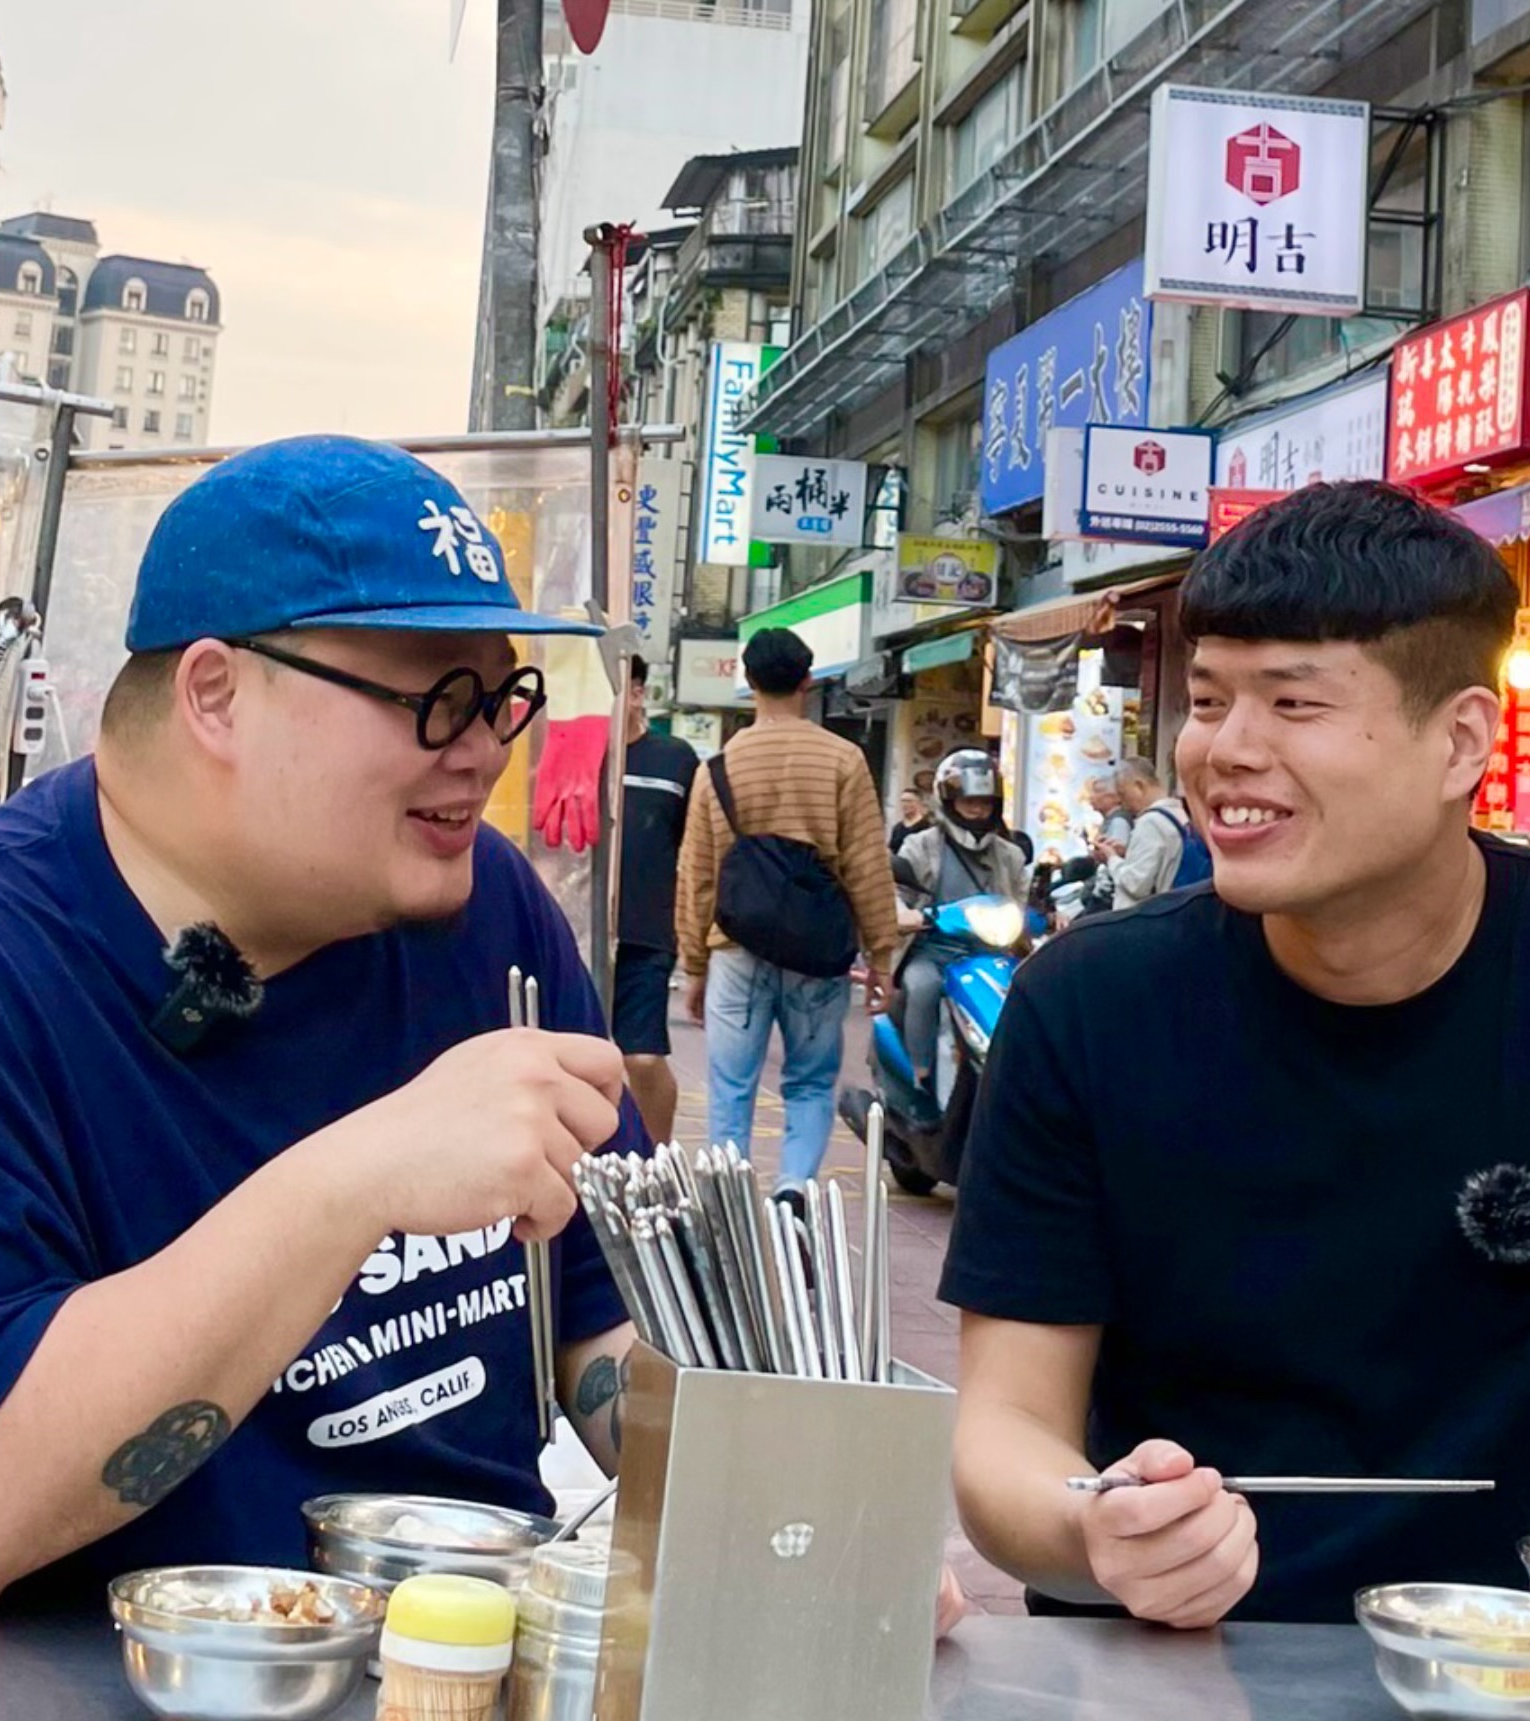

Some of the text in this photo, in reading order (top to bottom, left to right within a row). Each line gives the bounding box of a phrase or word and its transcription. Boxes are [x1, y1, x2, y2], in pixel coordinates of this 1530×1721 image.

[1205, 215, 1318, 276] 明吉
[1097, 484, 1200, 502] CUISINE
[417, 498, 501, 584] 福
[359, 1214, 517, 1295] SAND
[369, 1273, 527, 1360] MINI-MART
[327, 1414, 369, 1441] LOS
